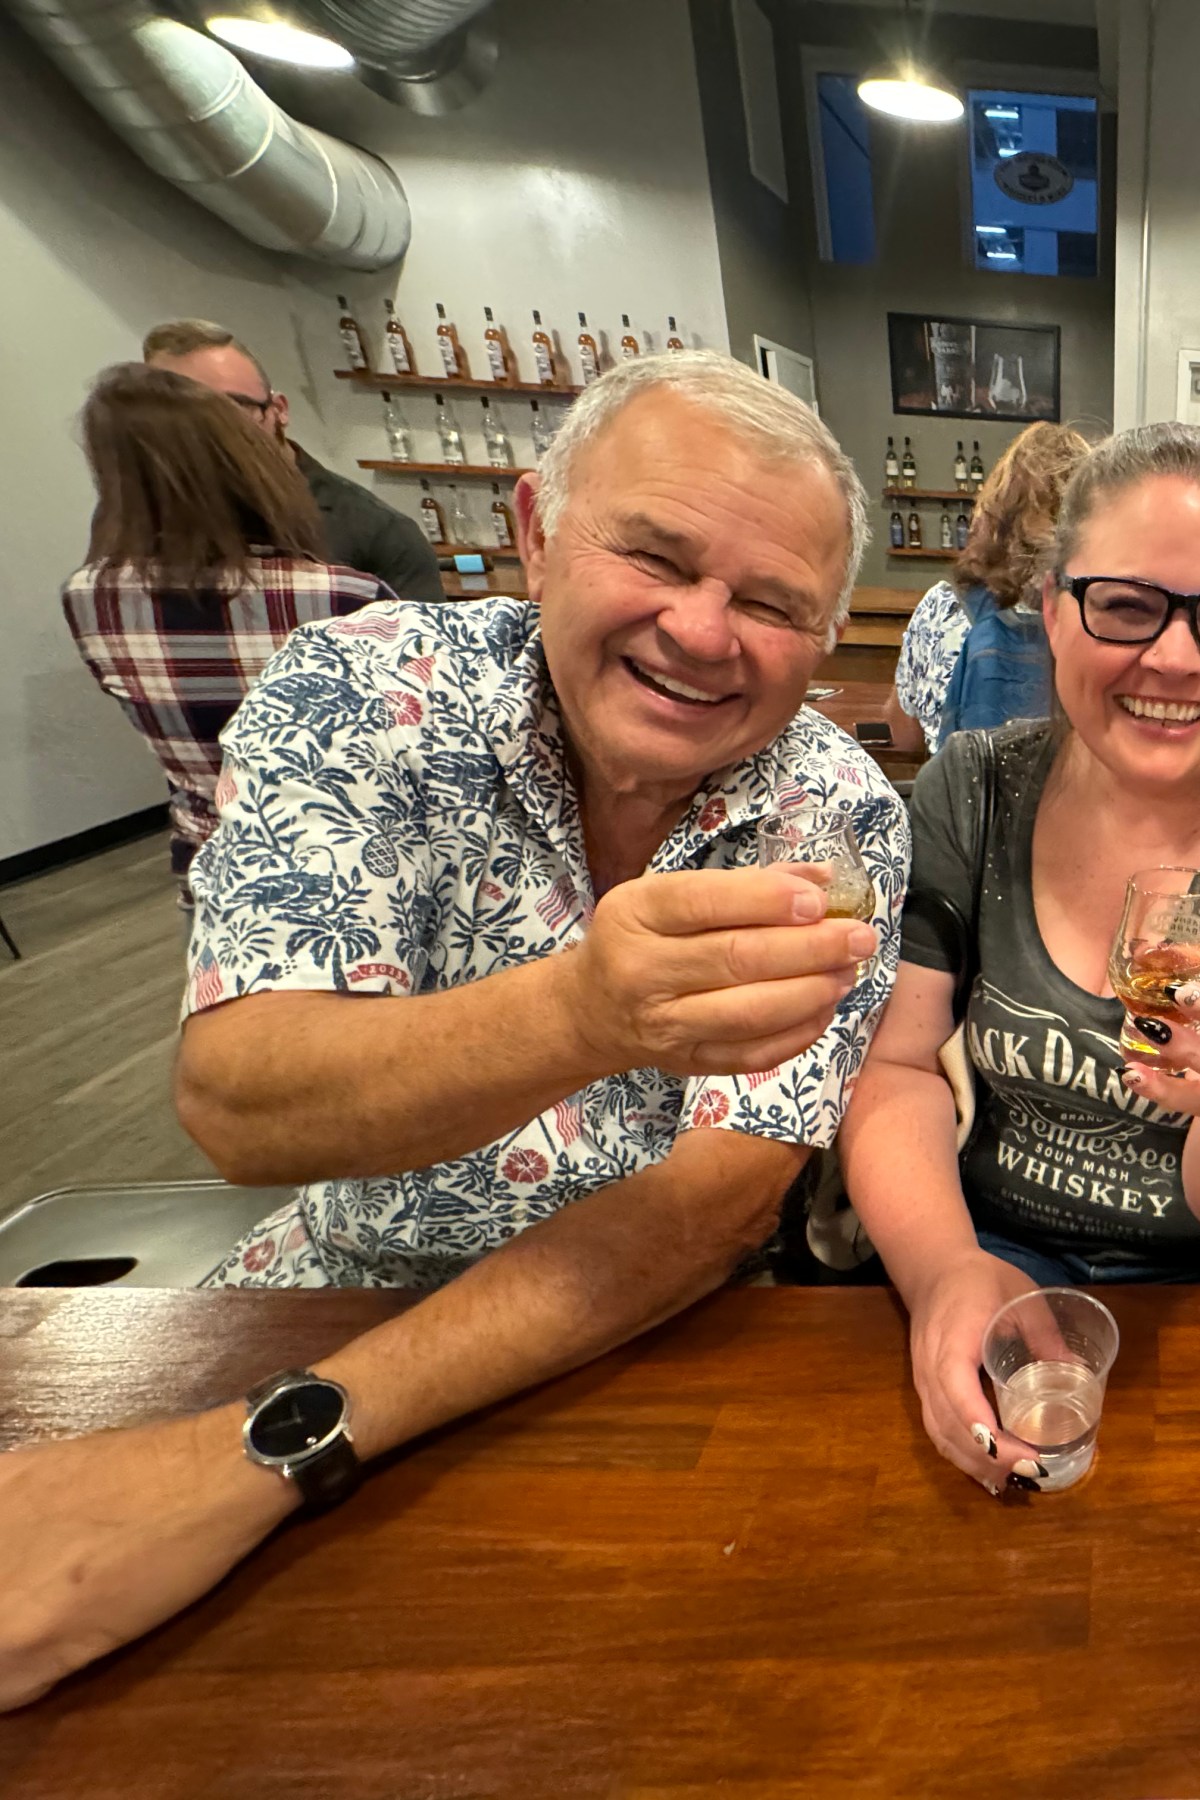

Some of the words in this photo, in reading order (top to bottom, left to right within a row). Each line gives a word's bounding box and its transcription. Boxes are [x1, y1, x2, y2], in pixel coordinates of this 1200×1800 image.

[997, 1141, 1172, 1218] WHISKEY
[1035, 1142, 1074, 1167] SOUR
[1083, 1159, 1129, 1182] MASH
